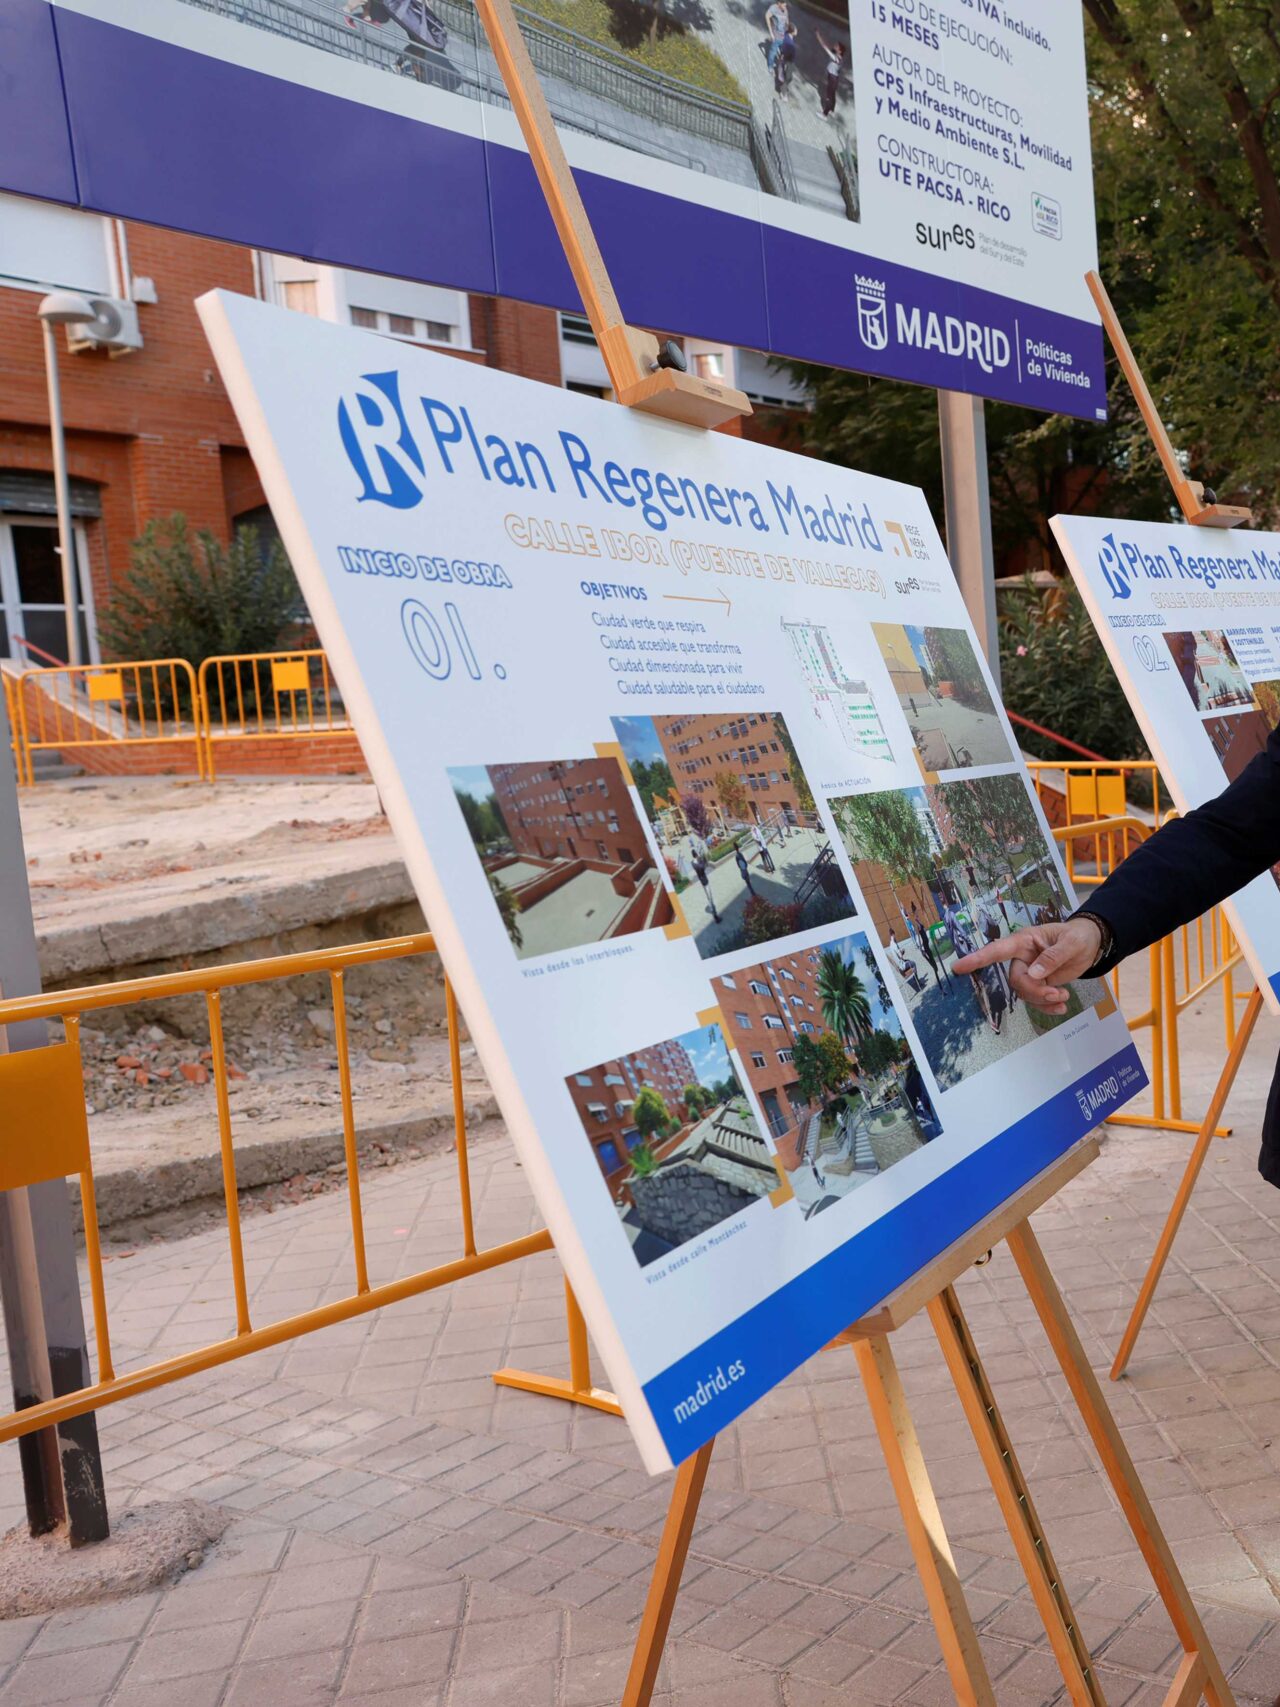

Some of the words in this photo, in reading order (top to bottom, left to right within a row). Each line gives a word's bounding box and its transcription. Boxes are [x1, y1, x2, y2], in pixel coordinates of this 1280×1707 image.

[871, 1, 886, 24] 15
[892, 11, 939, 50] MESES
[919, 2, 936, 27] DE
[939, 13, 1013, 66] EJECUCIÓN:
[977, 0, 1000, 23] IVA
[1003, 11, 1052, 52] incluido.
[872, 43, 923, 82] AUTOR
[926, 67, 950, 95] DEL
[953, 81, 1023, 127] PROYECTO:
[874, 68, 904, 96] CPS
[909, 83, 1017, 149] Infraestructuras,
[1020, 134, 1073, 171] Movilidad
[875, 96, 883, 115] y
[888, 100, 930, 130] Medio
[935, 118, 1000, 160] Ambiente
[1003, 150, 1025, 171] S.L.
[877, 134, 994, 195] CONSTRUCTORA:
[878, 157, 911, 186] UTE
[916, 172, 965, 206] PACSA
[977, 195, 1011, 222] RICO
[895, 302, 1011, 374] MADRID
[1025, 338, 1072, 366] Políticas
[1027, 360, 1042, 377] de
[1043, 363, 1091, 389] Vivienda
[419, 396, 557, 493] Plan
[557, 430, 770, 532] Regenera
[766, 479, 884, 553] Madrid
[337, 546, 417, 579] INICIO
[416, 555, 453, 582] DE
[451, 559, 513, 589] OBRA
[504, 513, 601, 558] CALLE
[600, 527, 669, 567] IBOR
[669, 539, 767, 579] (PUENTE
[764, 550, 796, 583] DE
[793, 558, 887, 600] VALLECAS)
[1120, 542, 1173, 579] Plan
[1168, 545, 1258, 590] Regenera
[580, 581, 648, 601] OBJETIVOS
[591, 612, 628, 628] Ciudad
[629, 618, 655, 630] verde
[658, 620, 674, 633] que
[676, 620, 707, 635] respira
[600, 634, 636, 650] Ciudad
[637, 638, 678, 652] accesible
[679, 643, 696, 656] que
[697, 641, 742, 655] transforma
[609, 657, 645, 673] Ciudad
[646, 659, 706, 674] dimensionada
[708, 664, 726, 676] para
[727, 662, 743, 674] vivir
[617, 680, 652, 695] Ciudad
[653, 681, 696, 695] saludable
[696, 685, 716, 698] para
[717, 682, 725, 695] el
[726, 681, 765, 695] ciudadano
[522, 968, 545, 979] Vista
[547, 960, 570, 973] desde
[1086, 1076, 1119, 1111] MADRID
[672, 1359, 746, 1424] madrid.es
